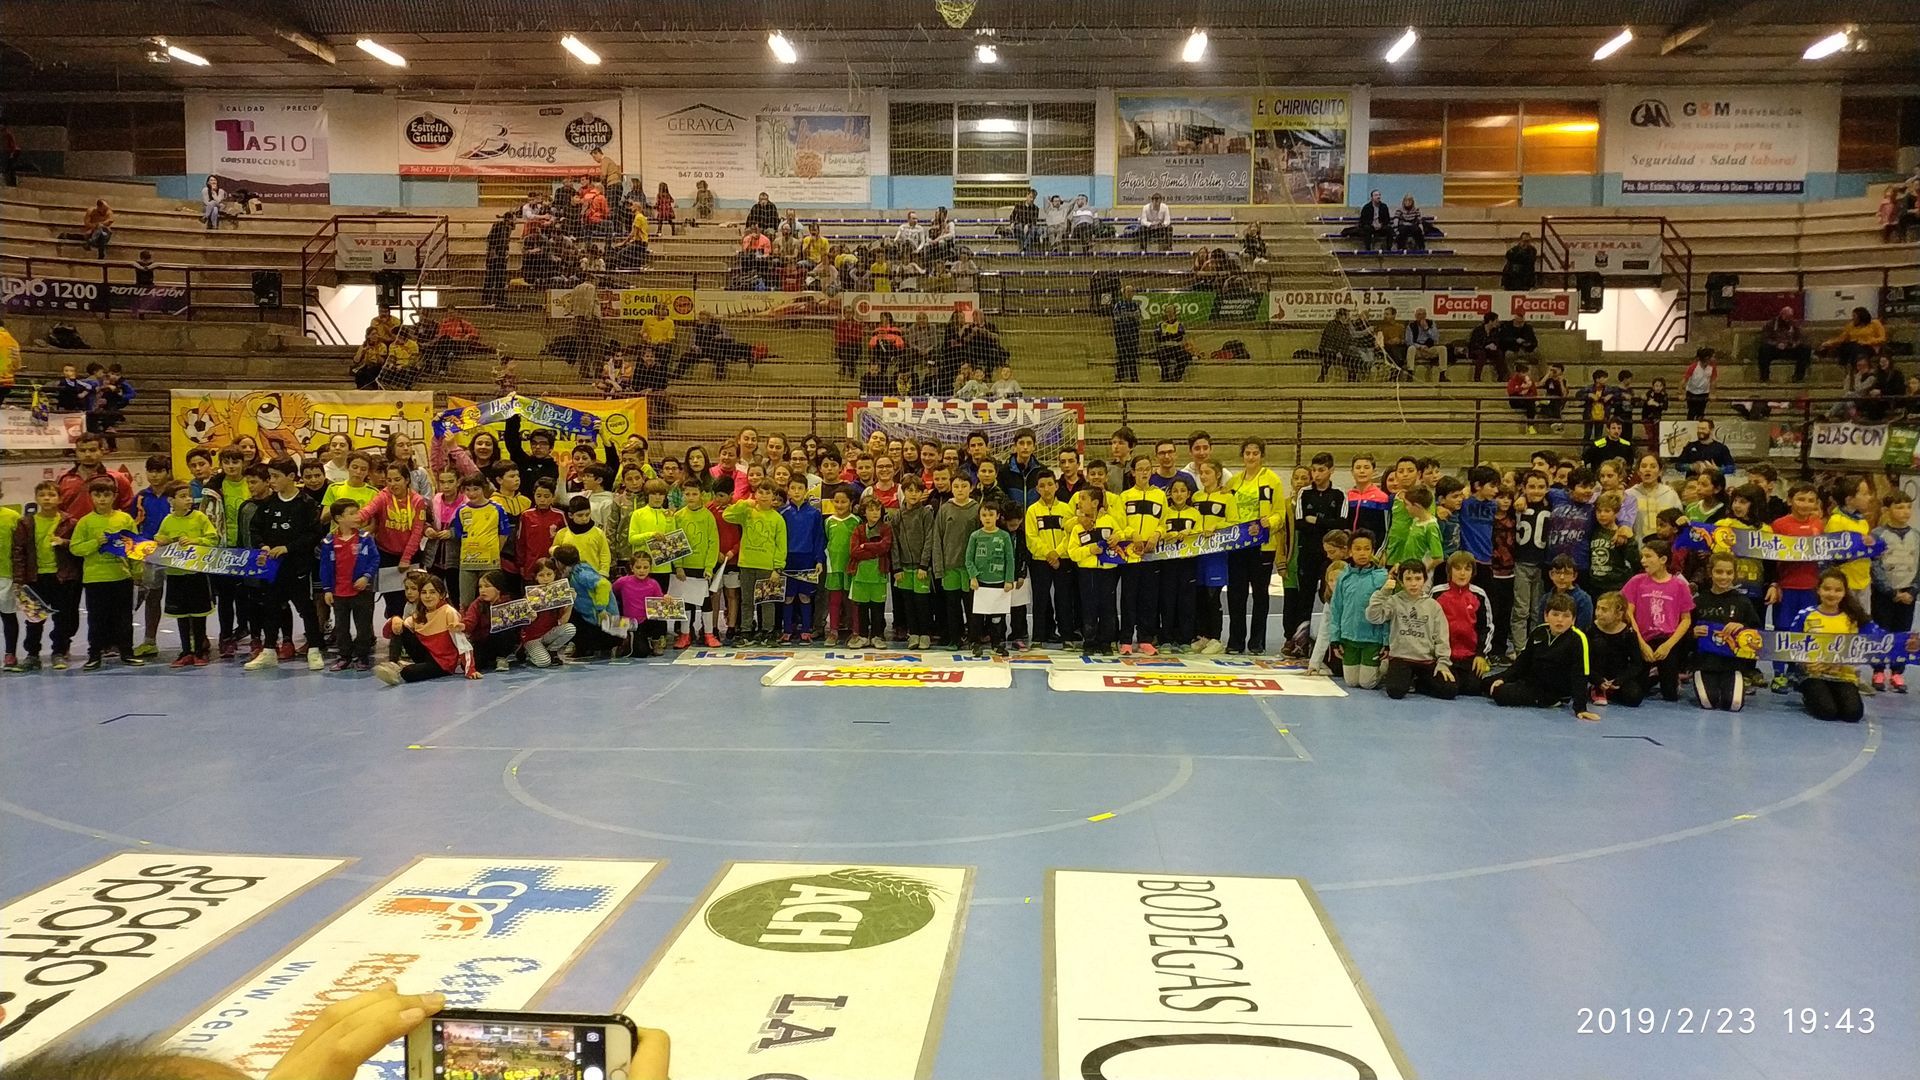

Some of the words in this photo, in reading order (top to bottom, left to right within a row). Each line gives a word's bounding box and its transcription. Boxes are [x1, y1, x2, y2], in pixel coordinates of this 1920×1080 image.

[1275, 98, 1345, 115] CHIRINGUITO
[411, 121, 449, 132] Estrella
[569, 123, 608, 132] Estrella
[667, 118, 735, 131] GERAYCA
[215, 119, 306, 152] TASIO
[412, 132, 447, 142] Galicia
[571, 132, 607, 143] Galicia
[221, 156, 296, 167] CONSTRUCCIONES
[1631, 154, 1697, 167] Seguridad
[1710, 153, 1746, 166] Salud
[1751, 154, 1797, 166] laboral
[1147, 171, 1158, 188] de
[51, 282, 98, 300] 1200
[881, 294, 899, 304] LA
[1363, 292, 1391, 305] S.L.
[1437, 297, 1489, 310] Peache
[1514, 297, 1566, 310] Peache
[313, 411, 349, 434] LA
[1816, 426, 1884, 448] BLASCON
[1515, 508, 1551, 549] 50
[1154, 538, 1187, 555] Hasta
[1208, 526, 1241, 549] final
[1748, 531, 1789, 551] Hasta
[1793, 537, 1808, 551] el
[1811, 531, 1853, 555] final
[161, 545, 197, 562] Hasta
[219, 549, 250, 568] final
[1774, 631, 1818, 653] Hasta
[1827, 637, 1843, 652] el
[1849, 633, 1895, 659] final
[803, 669, 951, 682] Pascual
[1112, 677, 1266, 689] Pascual
[0, 864, 213, 962] sport
[757, 883, 872, 946] ACH
[24, 876, 267, 986] prado
[1137, 879, 1259, 1012] BODEGAS
[750, 993, 848, 1052] LA
